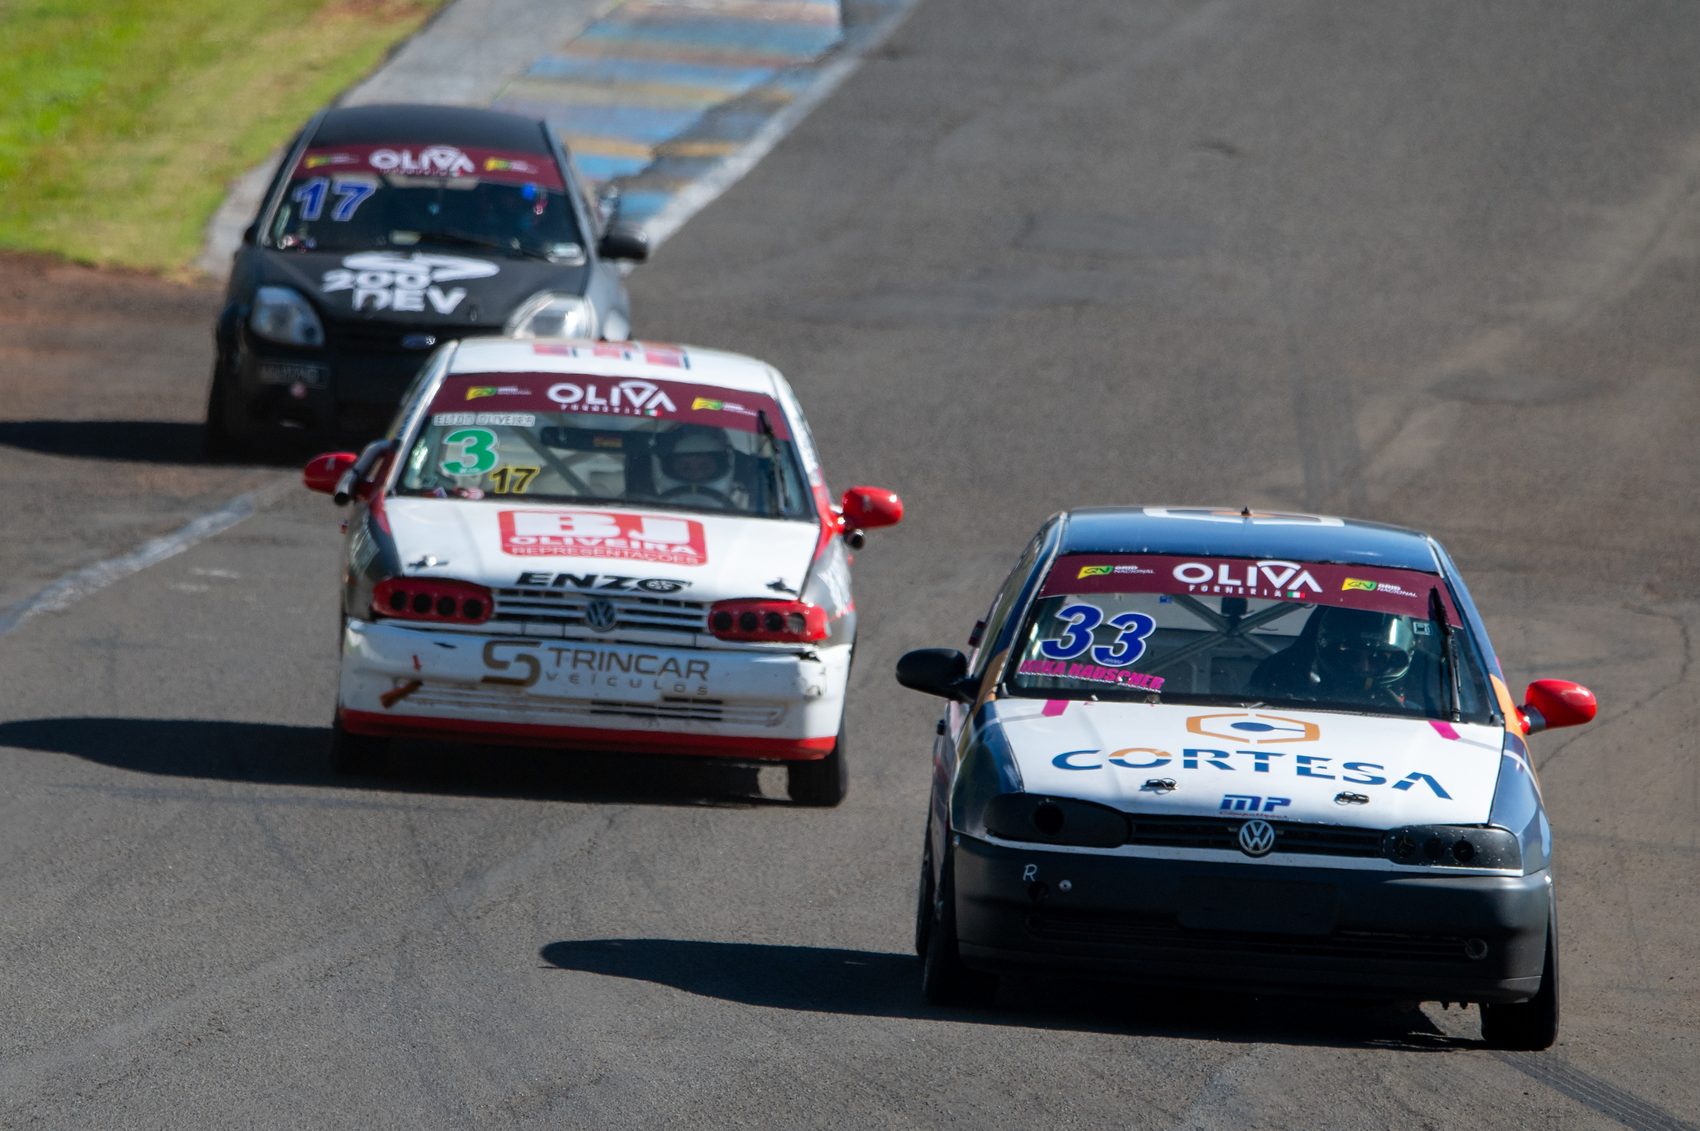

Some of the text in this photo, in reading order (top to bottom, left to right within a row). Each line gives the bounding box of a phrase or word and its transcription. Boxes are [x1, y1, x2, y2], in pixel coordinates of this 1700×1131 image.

[369, 145, 476, 174] OLIVA
[293, 176, 379, 223] 17
[546, 378, 677, 413] OLIVA
[440, 427, 498, 476] 3
[489, 464, 541, 495] 17
[513, 511, 691, 545] BJ
[509, 535, 698, 556] OLIVEIRA
[1172, 560, 1323, 593] OLIVA
[1188, 583, 1282, 598] FORNERIA
[1040, 602, 1157, 667] 33
[548, 646, 710, 681] TRINCAR
[1051, 747, 1453, 801] CORTESA
[1220, 794, 1292, 812] MP
[1023, 863, 1038, 881] R
